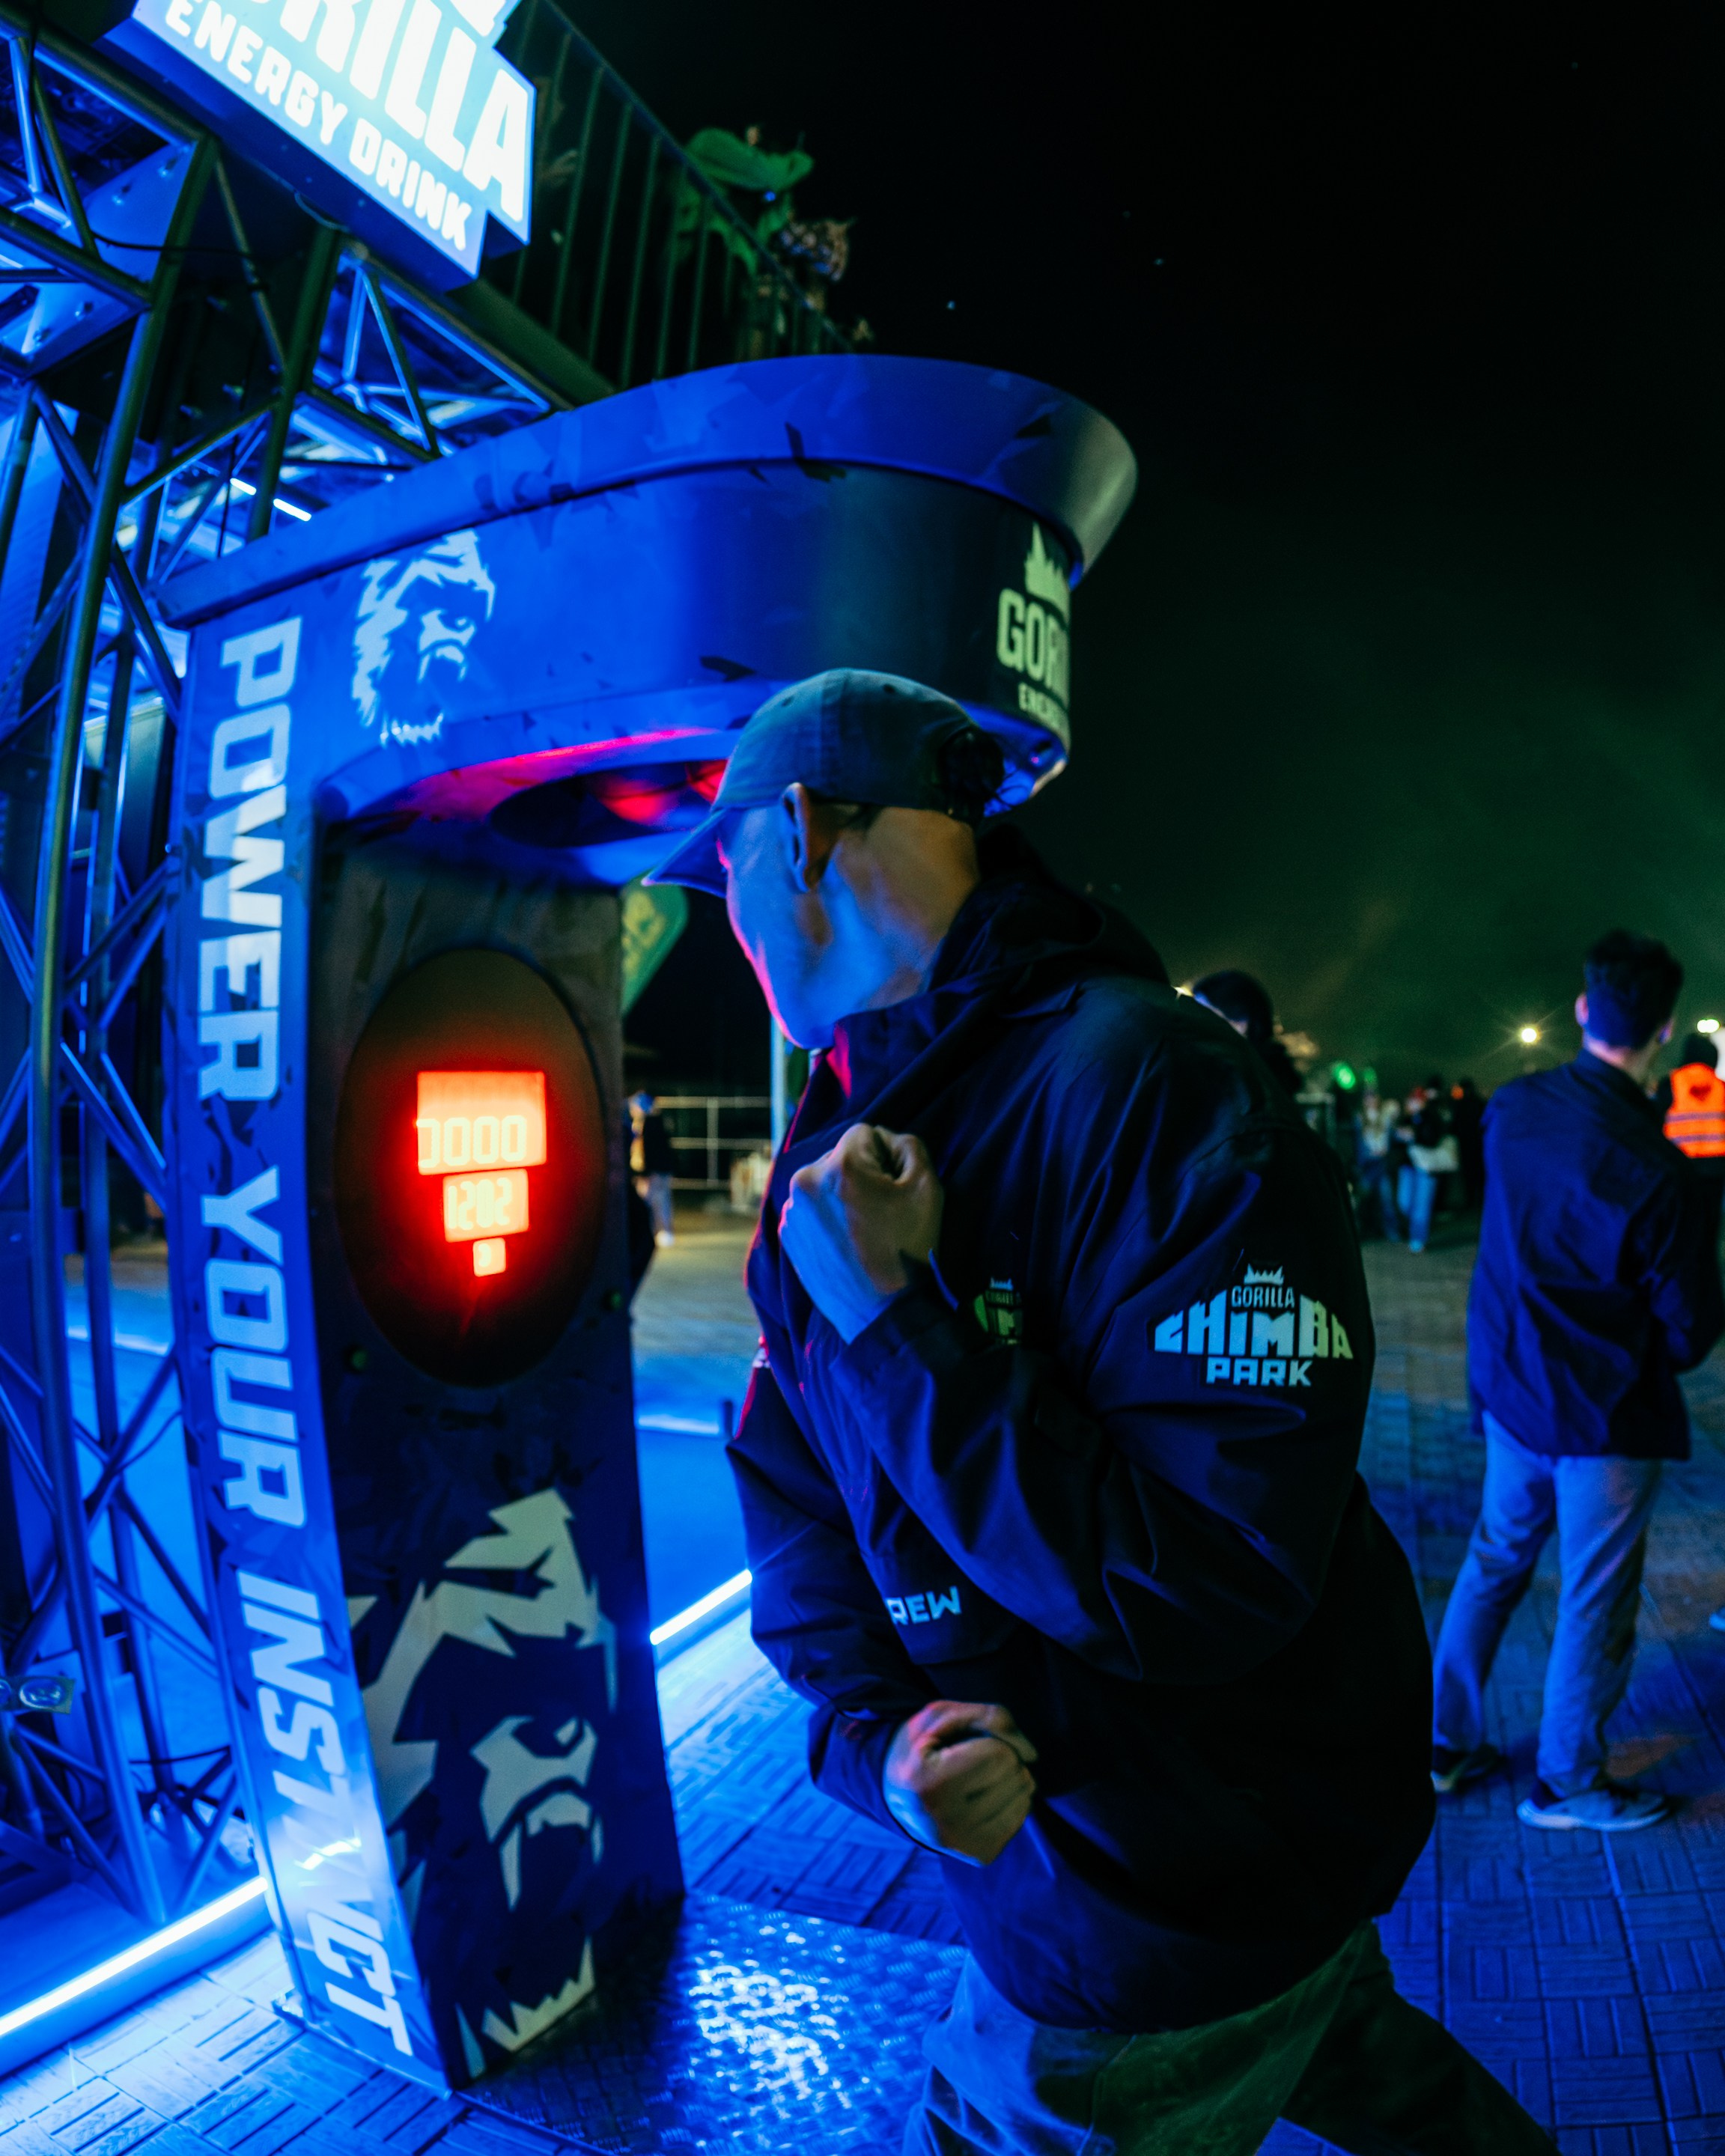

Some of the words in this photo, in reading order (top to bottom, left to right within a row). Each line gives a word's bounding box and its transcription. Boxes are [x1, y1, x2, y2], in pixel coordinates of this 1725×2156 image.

[165, 0, 348, 145] ENERGY
[349, 118, 472, 251] DRINK
[198, 615, 301, 1101] POWER
[201, 1165, 306, 1527] YOUR
[1154, 1288, 1354, 1359] CHIMBA
[1206, 1356, 1312, 1386] PARK
[1232, 1285, 1295, 1309] GORILLA
[237, 1569, 413, 2057] INSTINCT
